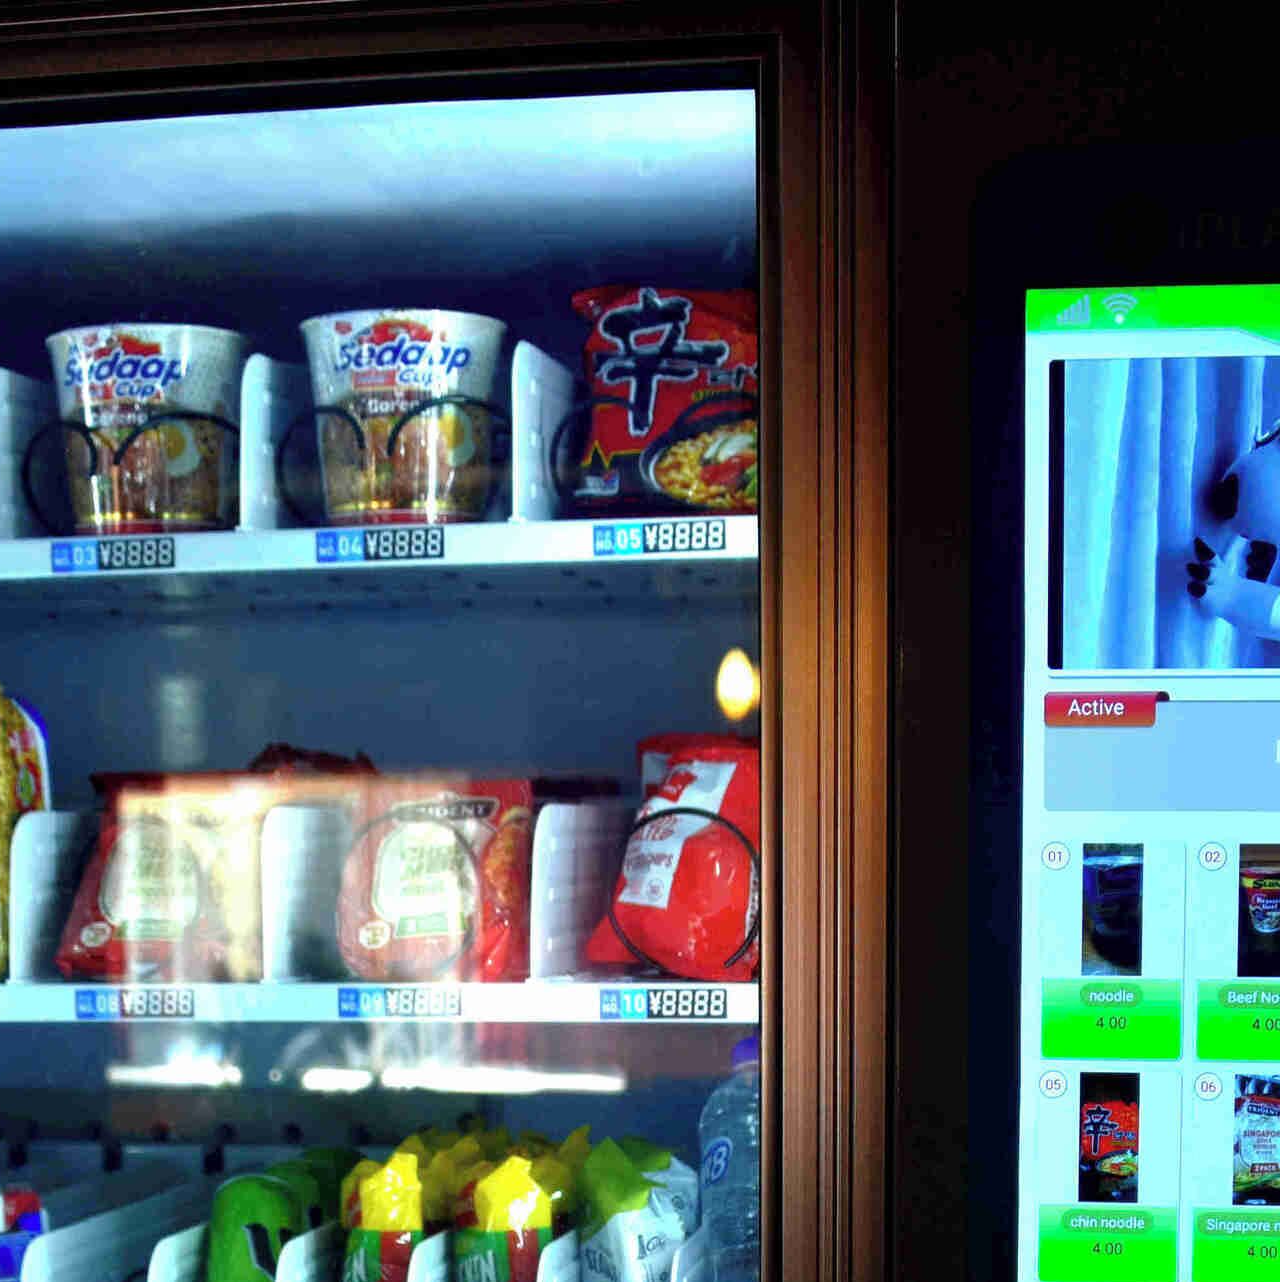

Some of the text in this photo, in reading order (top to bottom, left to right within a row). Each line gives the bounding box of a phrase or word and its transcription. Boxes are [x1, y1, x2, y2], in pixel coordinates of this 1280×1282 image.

[115, 383, 157, 400] Cup
[338, 526, 443, 560] 04 ¥8888
[616, 519, 726, 552] 05 ¥8888
[98, 538, 175, 570] ¥8888
[1067, 697, 1125, 718] Active
[1047, 850, 1064, 863] 01
[1204, 851, 1221, 864] 02
[622, 988, 727, 1018] 10 ¥8888
[1088, 988, 1135, 1004] noodle
[1227, 990, 1259, 1005] Beef
[1044, 1078, 1061, 1091] 05
[1200, 1081, 1217, 1093] 06
[1070, 1214, 1146, 1231] chin noodle
[1205, 1218, 1272, 1235] Singapore
